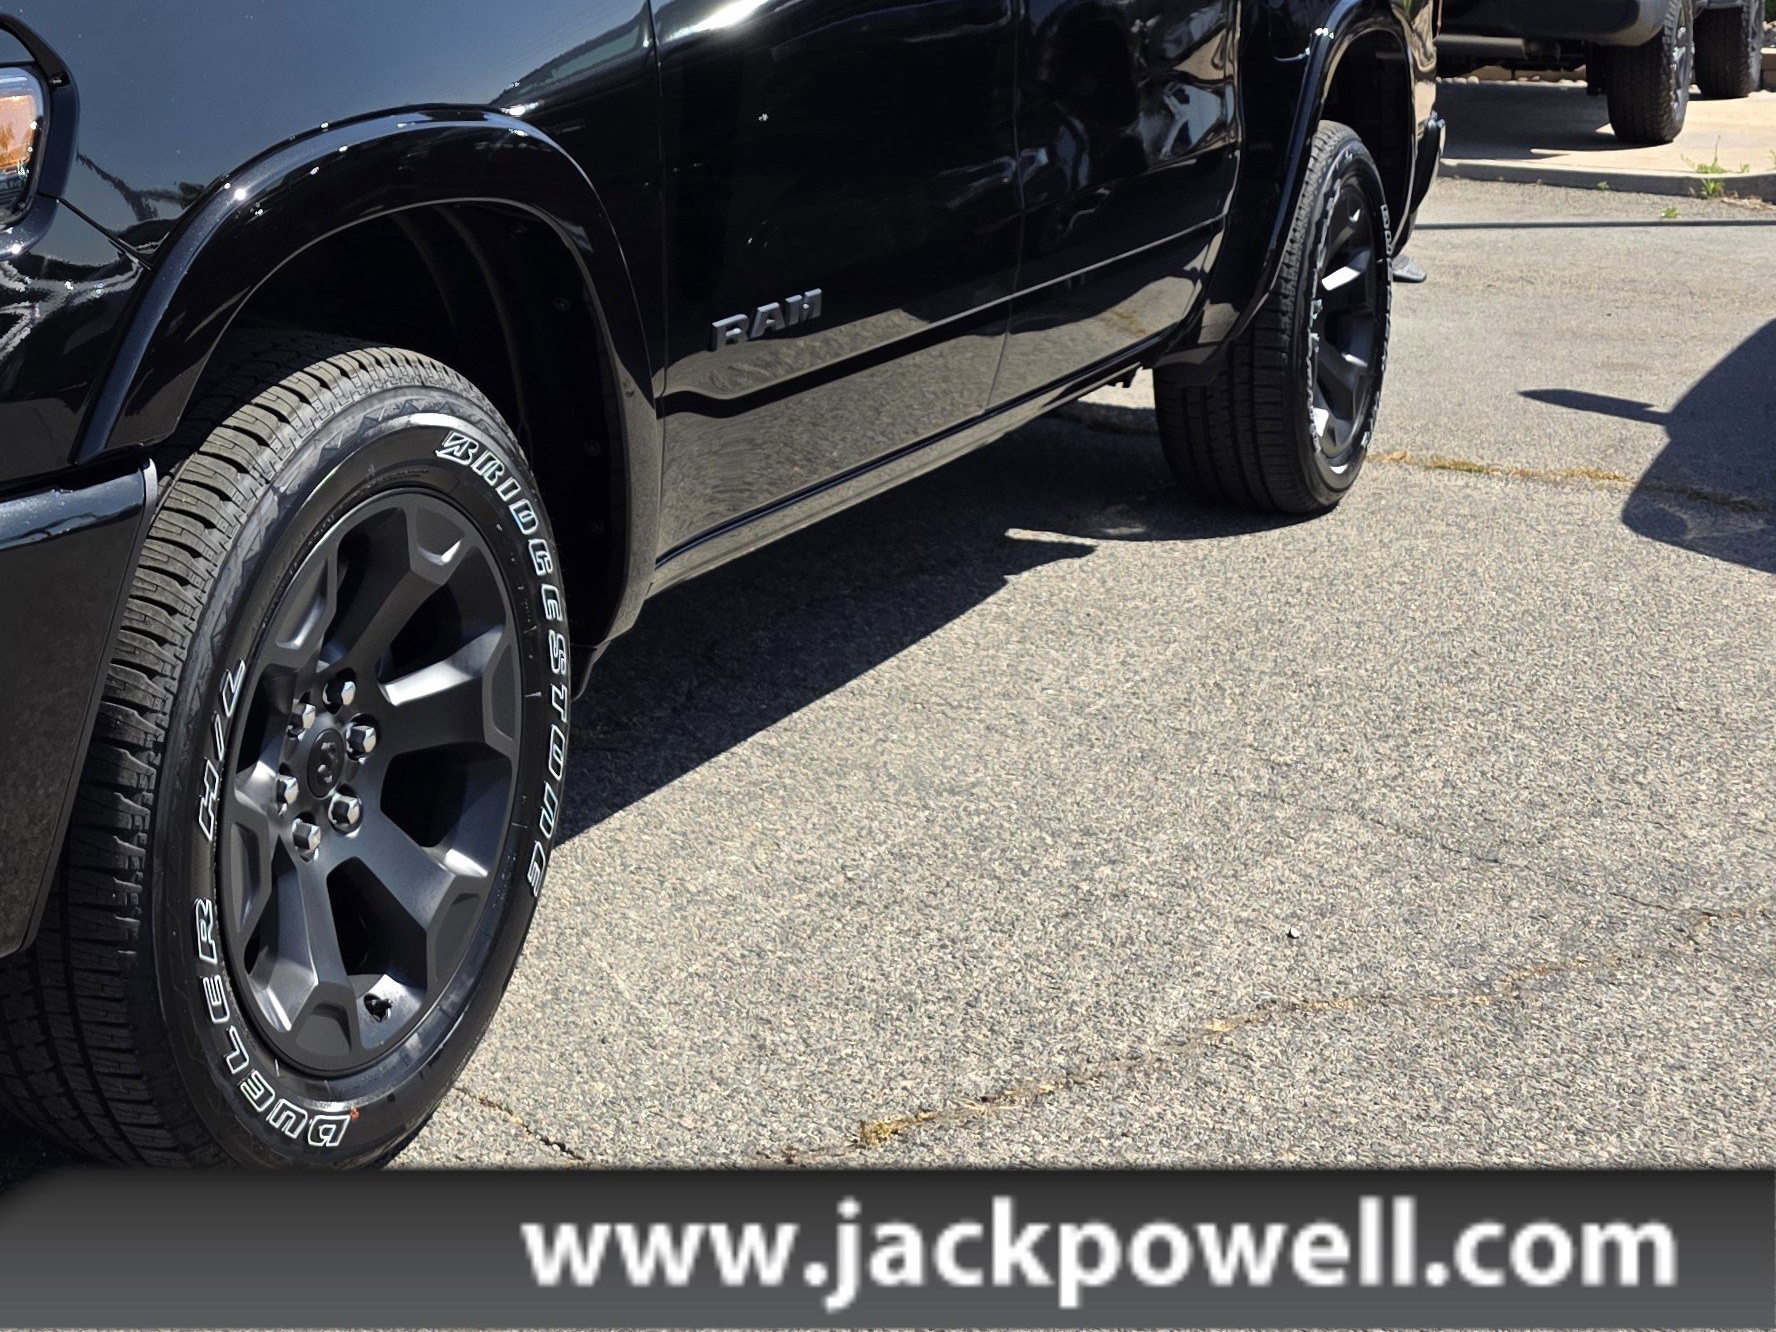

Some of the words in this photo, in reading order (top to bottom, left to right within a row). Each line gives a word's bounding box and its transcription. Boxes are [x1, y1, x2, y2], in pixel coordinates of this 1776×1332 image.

[708, 288, 823, 352] RAM
[435, 431, 569, 899] BRIDGESTONE
[194, 897, 351, 1148] DUELER
